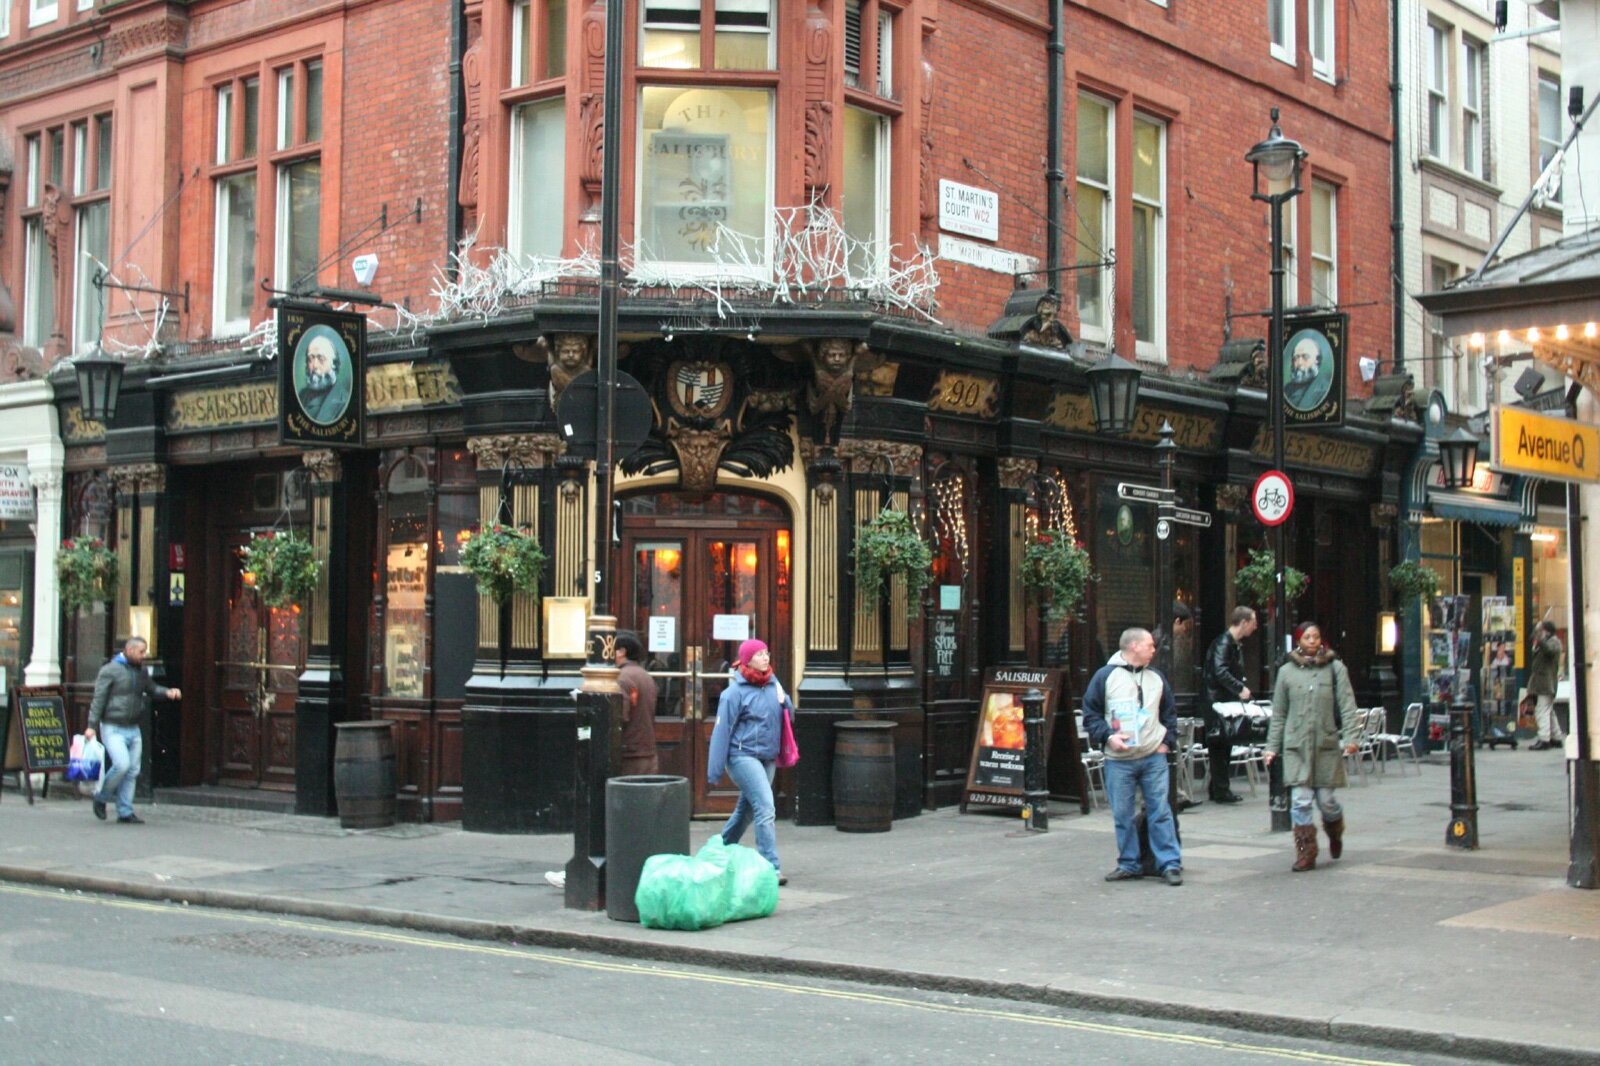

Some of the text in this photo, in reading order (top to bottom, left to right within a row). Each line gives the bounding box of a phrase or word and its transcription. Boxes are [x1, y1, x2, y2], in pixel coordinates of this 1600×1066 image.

[945, 186, 993, 209] ST MARTIN'S
[945, 201, 990, 224] COURT WC2
[366, 369, 443, 402] UFFET
[952, 380, 979, 408] 90
[311, 417, 350, 437] SALISBURY
[1312, 440, 1368, 467] SPIRITS
[1518, 425, 1585, 471] Avenue Q
[995, 670, 1048, 684] SALISBURY
[27, 707, 54, 718] ROAST
[25, 718, 62, 729] DINNERS
[28, 735, 64, 747] SERVED
[991, 750, 1014, 761] Receive
[1000, 761, 1025, 771] welcom
[970, 793, 985, 802] 020
